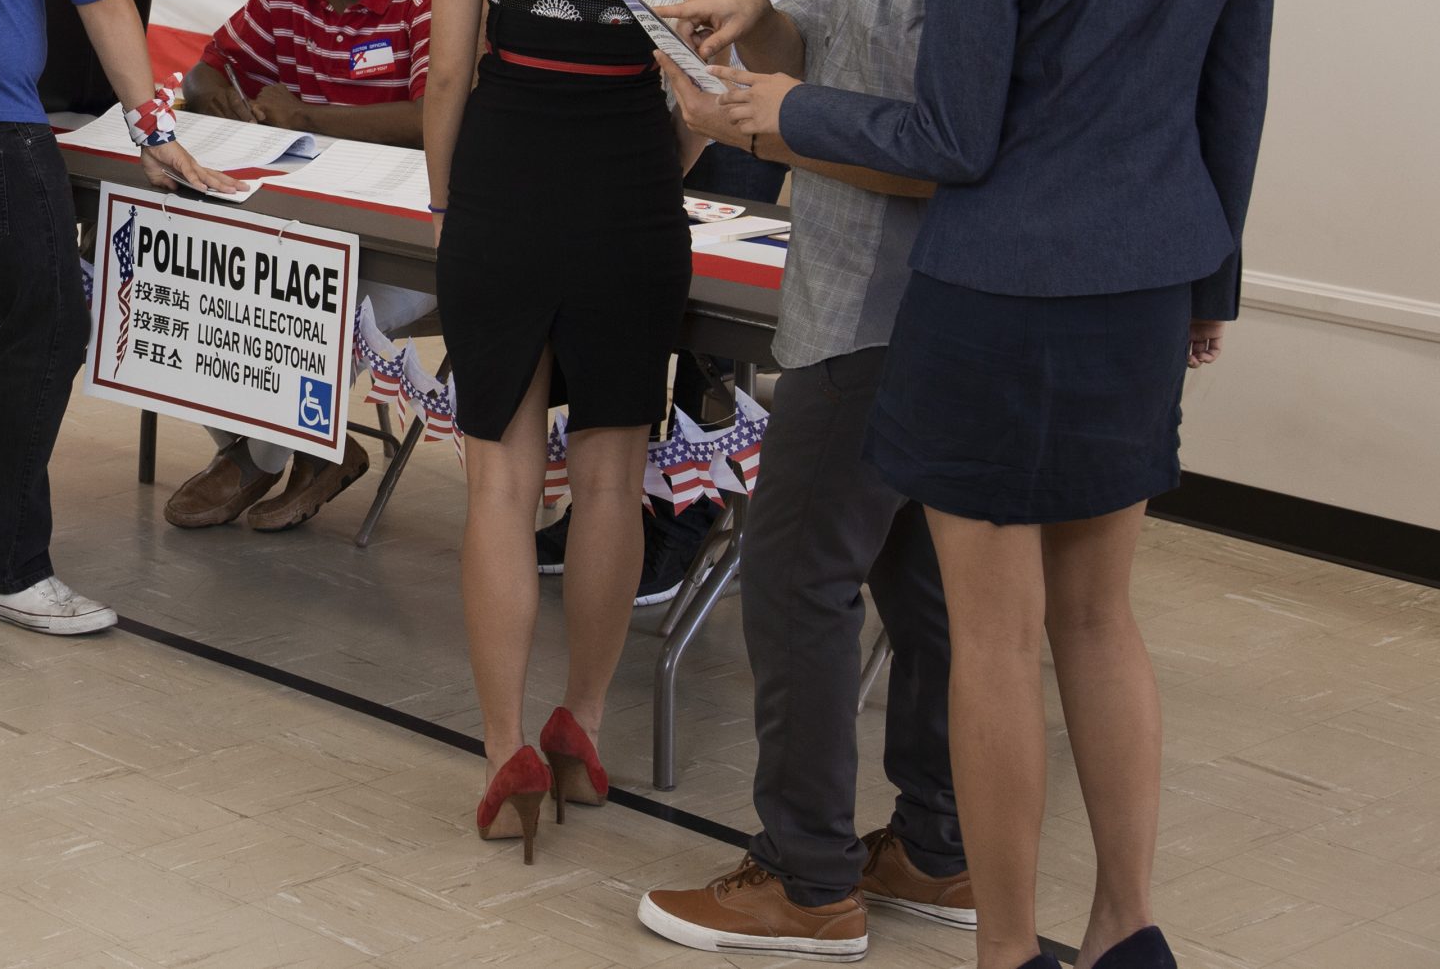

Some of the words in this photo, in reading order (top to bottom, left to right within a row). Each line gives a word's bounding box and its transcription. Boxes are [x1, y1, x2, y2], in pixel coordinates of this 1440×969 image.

[137, 225, 246, 291] POLLING
[254, 251, 338, 314] PLACE
[135, 280, 190, 311] 投票站
[133, 309, 189, 341] 投票所
[199, 294, 251, 326] CASILLA
[253, 307, 328, 345] ELECTORAL
[133, 339, 182, 369] 투표소
[197, 324, 240, 354] LUGAR
[243, 334, 261, 359] NG
[264, 340, 326, 376] BOTOHAN
[195, 351, 240, 383] PHÒNG
[243, 365, 280, 394] PHIẾU
